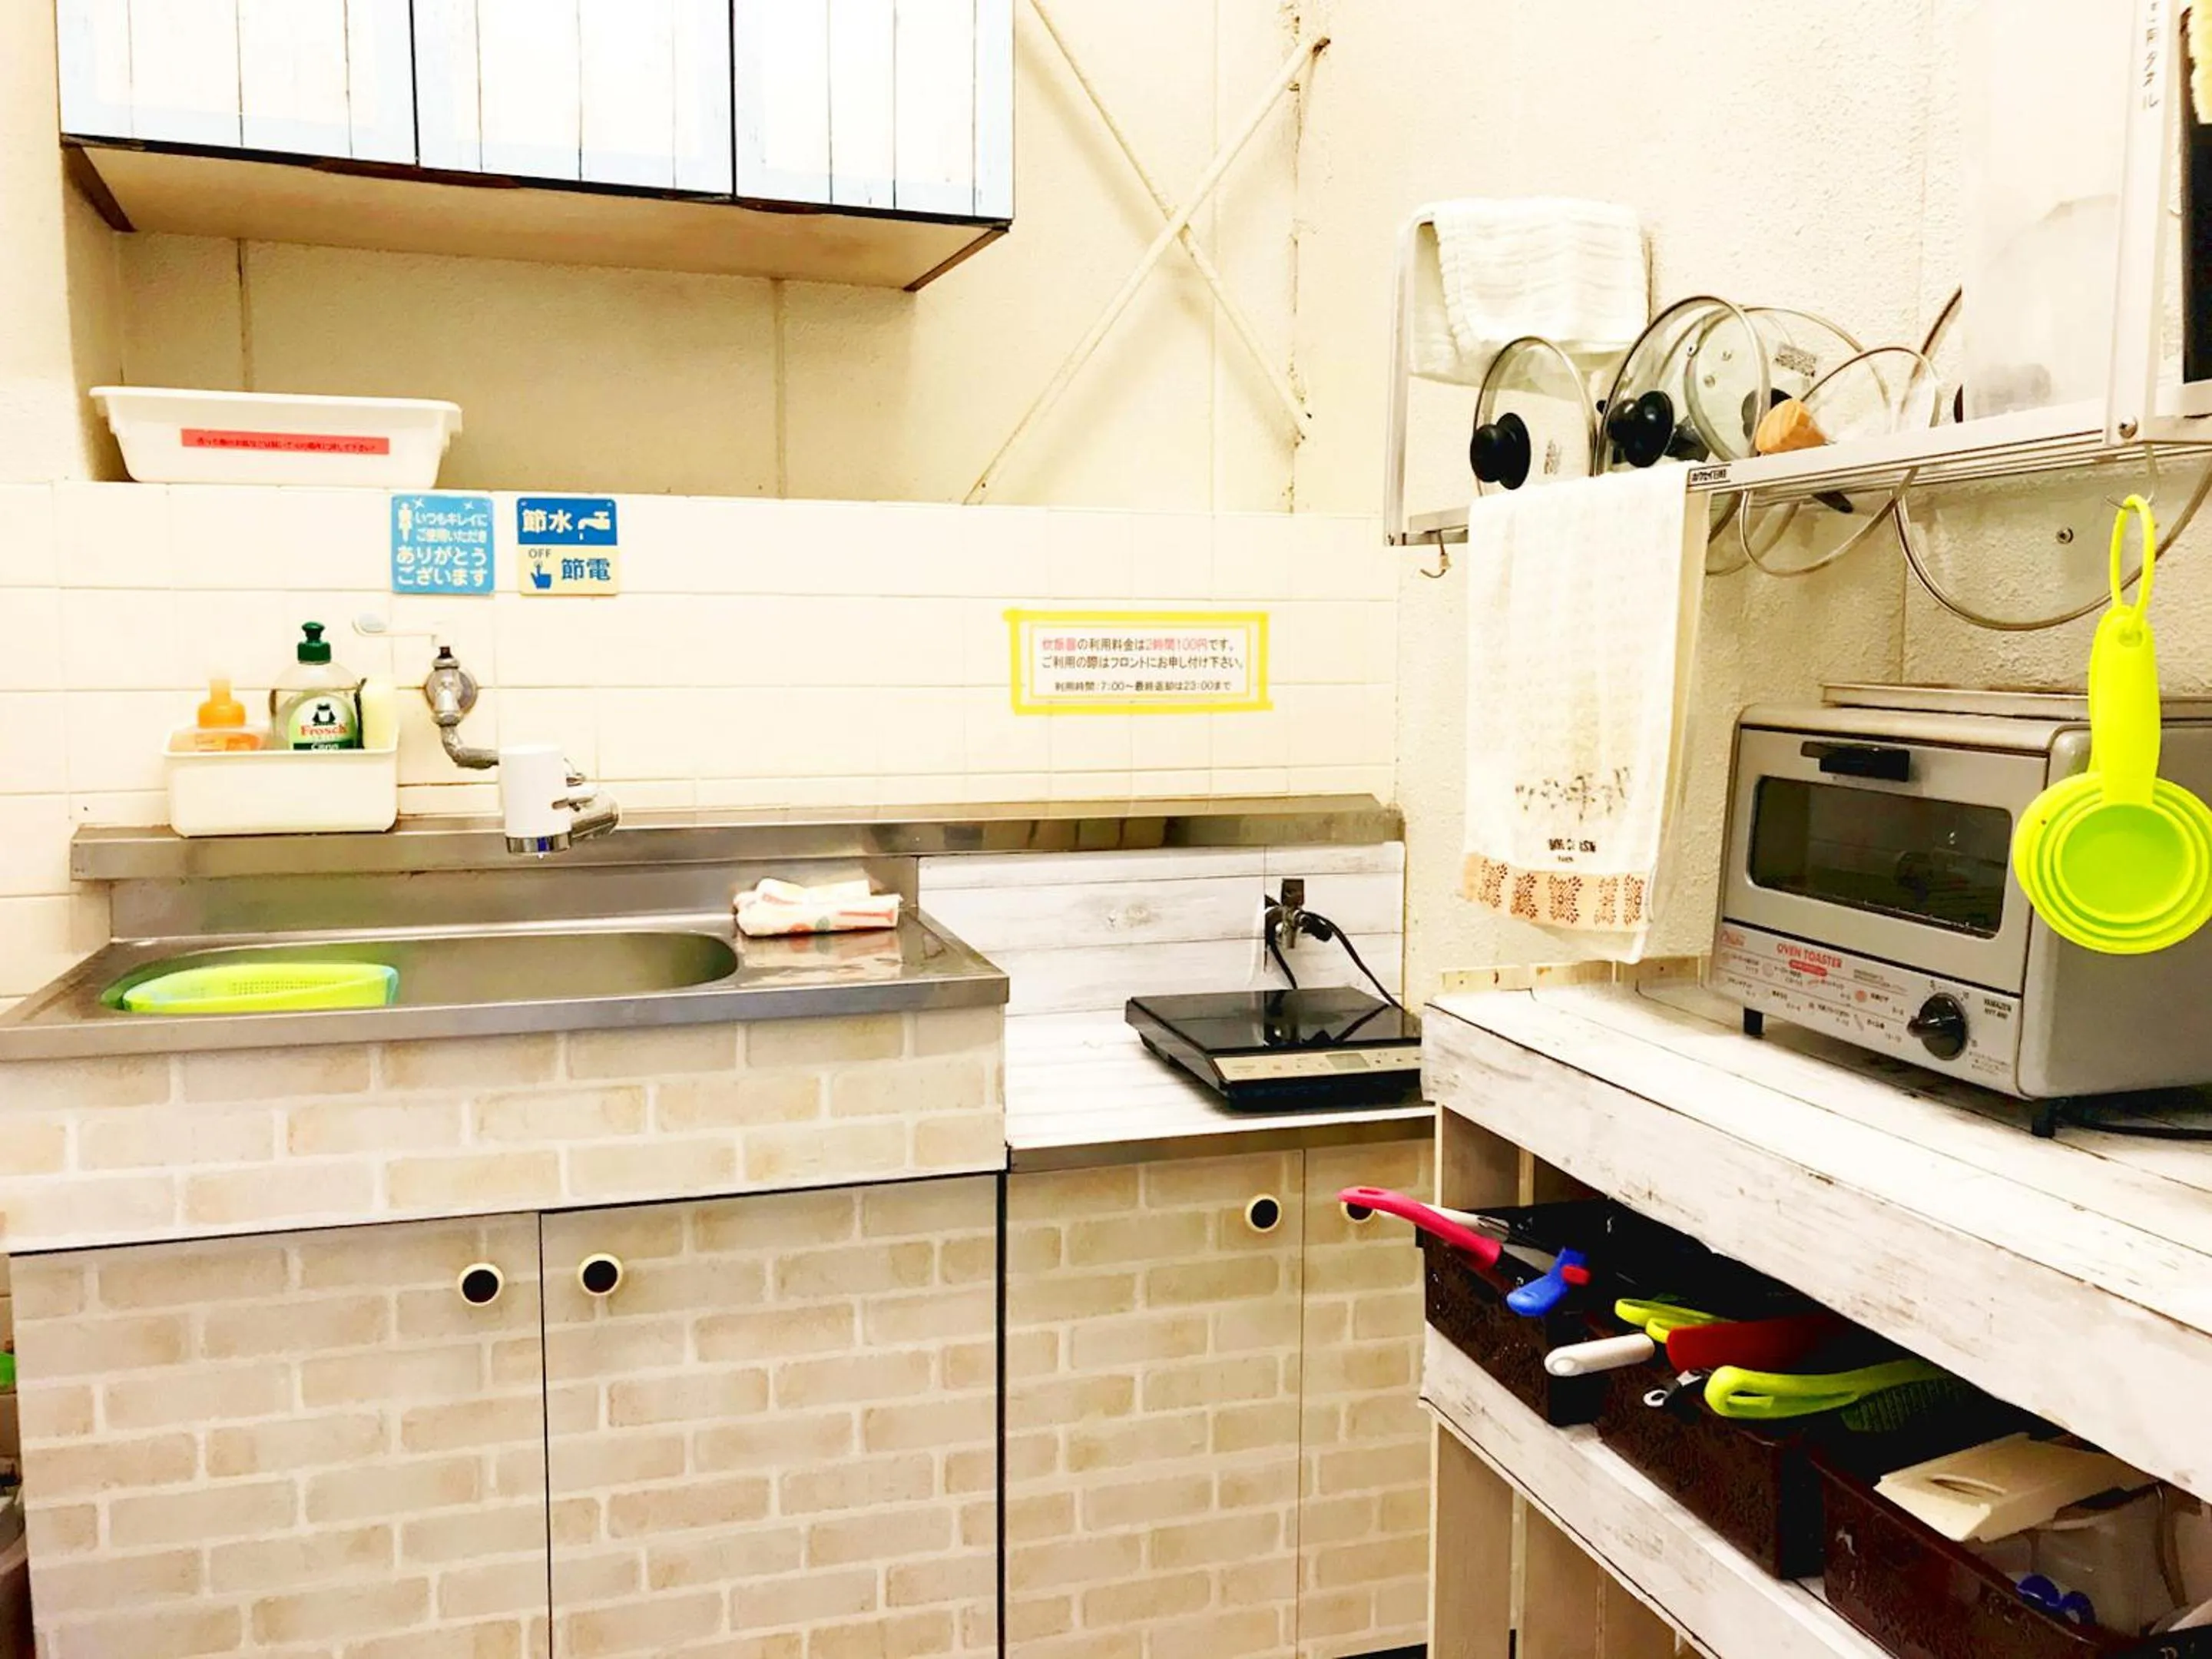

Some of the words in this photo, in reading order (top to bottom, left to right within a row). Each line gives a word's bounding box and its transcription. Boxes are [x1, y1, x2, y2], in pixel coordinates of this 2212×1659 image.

[416, 512, 487, 526] いつもキレイに
[522, 508, 573, 533] 節水
[396, 545, 487, 566] ありがとう
[528, 548, 551, 558] OFF
[397, 565, 488, 587] ございます
[561, 558, 611, 581] 節電
[300, 723, 348, 736] Frosch
[1777, 943, 1801, 957] OVEN
[1803, 949, 1843, 968] TOASTER
